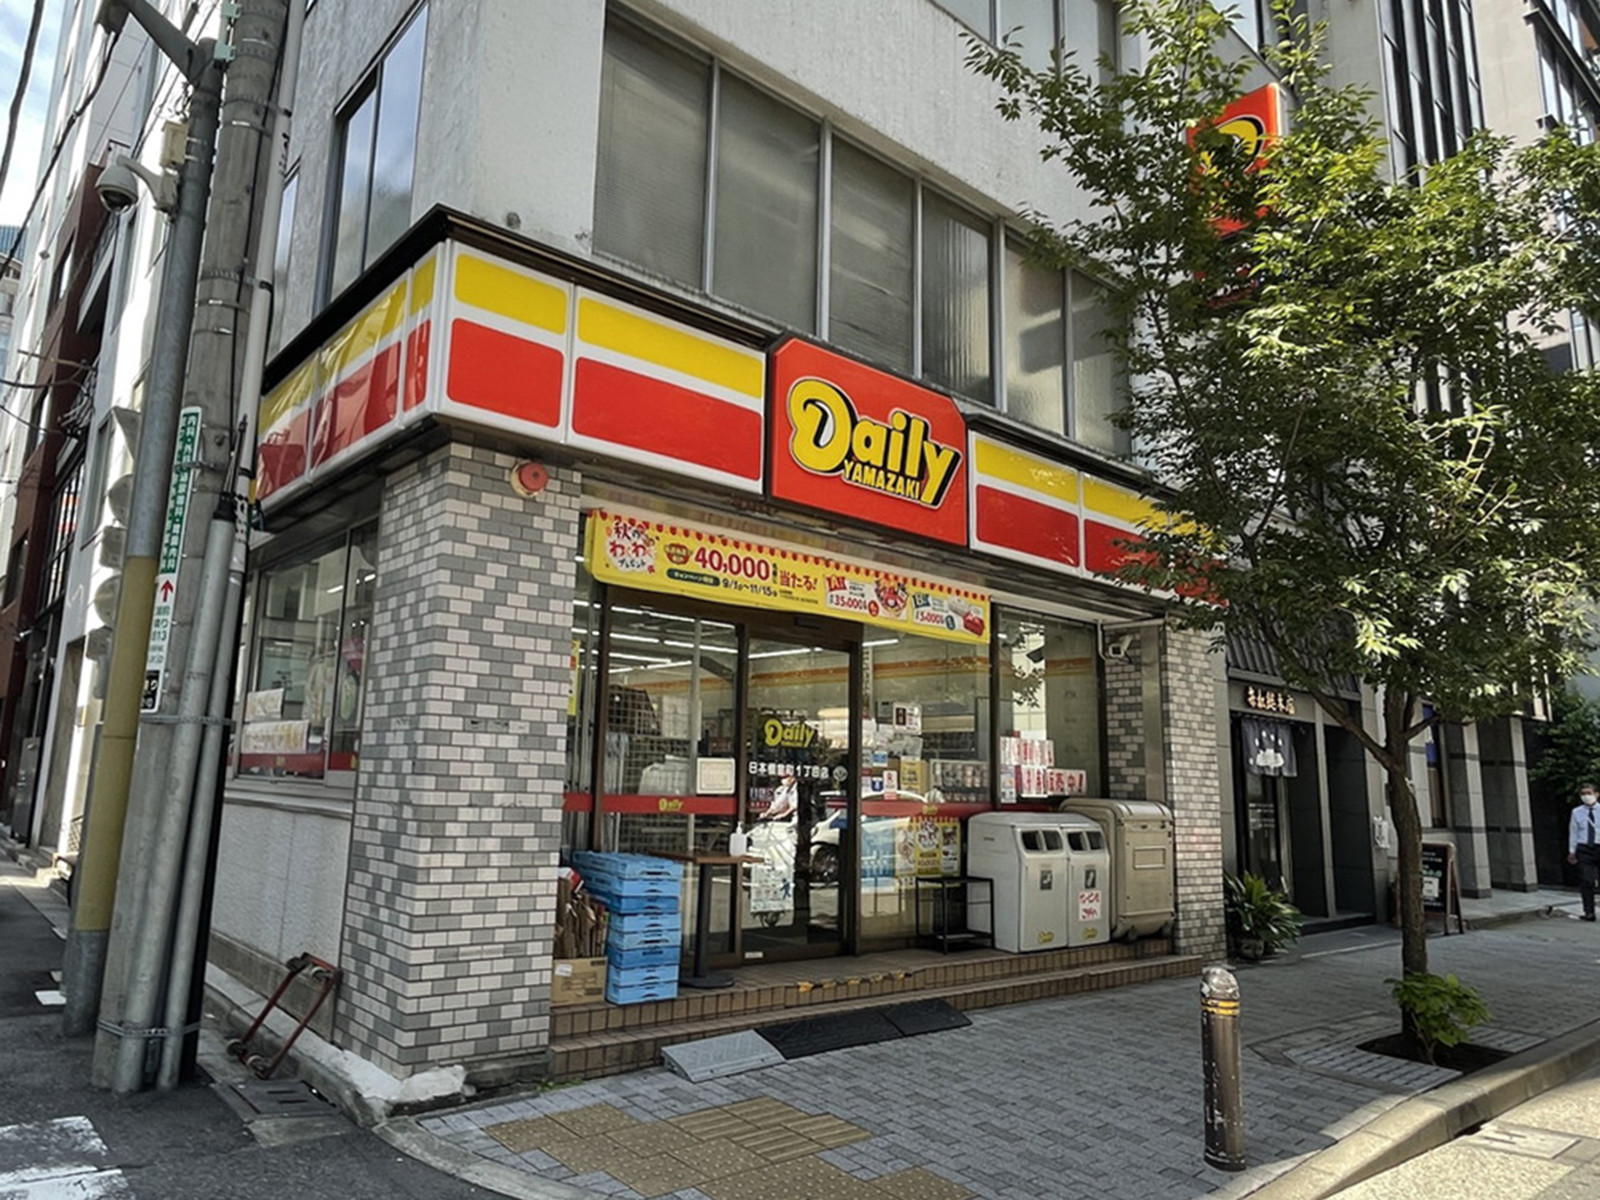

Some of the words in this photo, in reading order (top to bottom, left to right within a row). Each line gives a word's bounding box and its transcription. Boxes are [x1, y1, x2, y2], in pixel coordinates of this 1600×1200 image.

[788, 377, 962, 508] Daily
[843, 459, 921, 500] YAMAZAKI
[695, 546, 770, 581] 40,000
[764, 719, 815, 748] Daily
